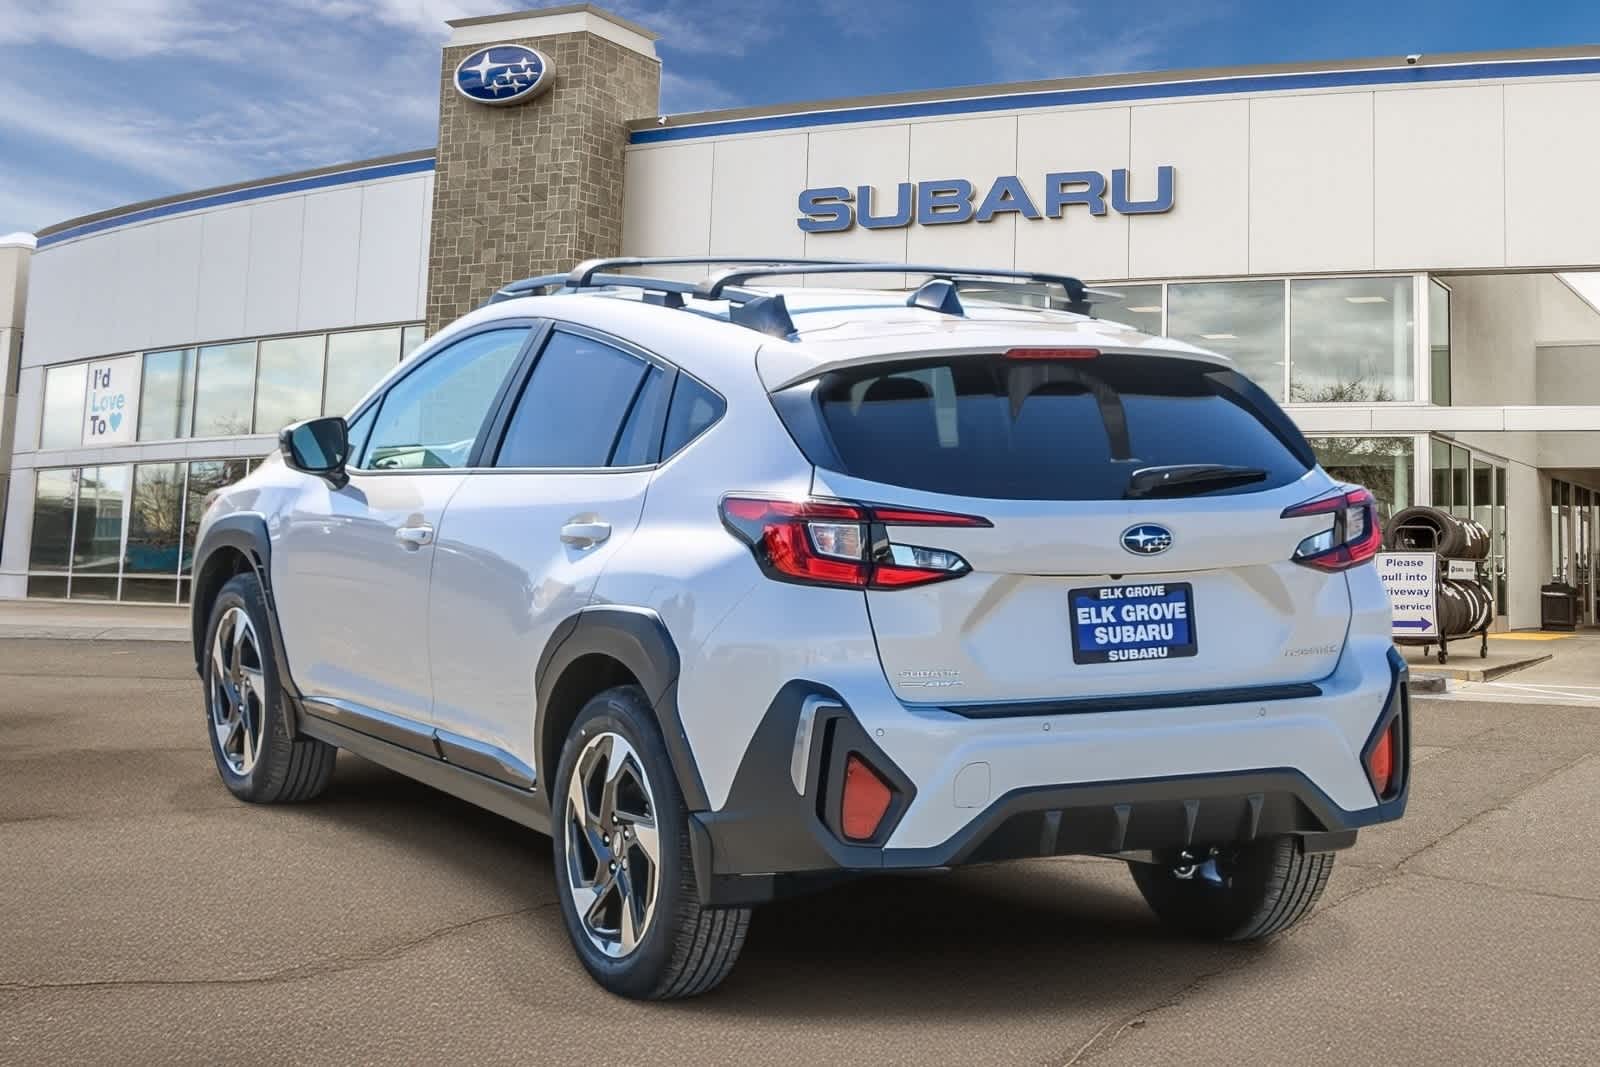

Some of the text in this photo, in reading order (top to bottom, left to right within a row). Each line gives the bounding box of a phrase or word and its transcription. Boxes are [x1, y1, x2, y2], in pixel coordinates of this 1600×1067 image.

[797, 165, 1177, 233] SUBARU
[94, 368, 111, 389] I'd
[92, 392, 125, 412] Love
[91, 415, 106, 434] To
[1386, 559, 1424, 567] Please
[1405, 573, 1428, 581] into
[1099, 585, 1165, 600] ELK GROVE
[1386, 588, 1430, 598] riveway
[1077, 602, 1187, 624] ELK GROVE
[1094, 623, 1174, 645] SUBARU
[1108, 646, 1168, 661] SUBARU
